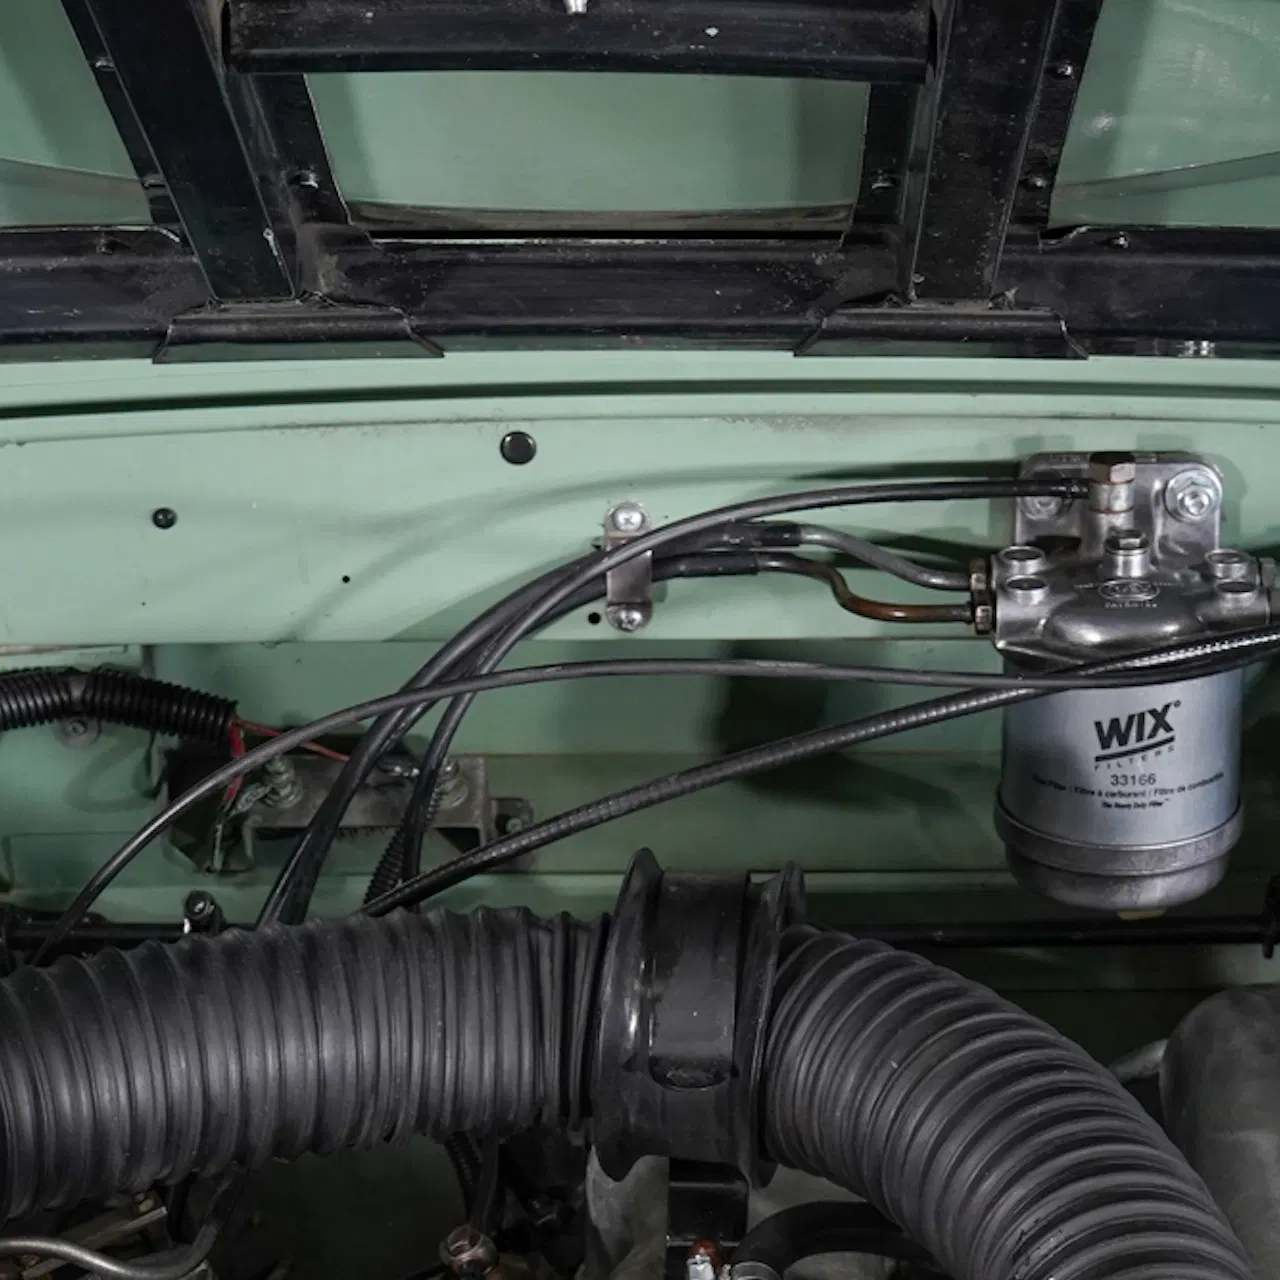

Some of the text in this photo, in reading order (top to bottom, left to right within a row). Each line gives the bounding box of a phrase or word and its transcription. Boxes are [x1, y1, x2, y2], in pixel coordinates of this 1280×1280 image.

[1094, 702, 1174, 750] WIX
[1095, 746, 1174, 771] FILTERS
[1110, 773, 1157, 787] 33166
